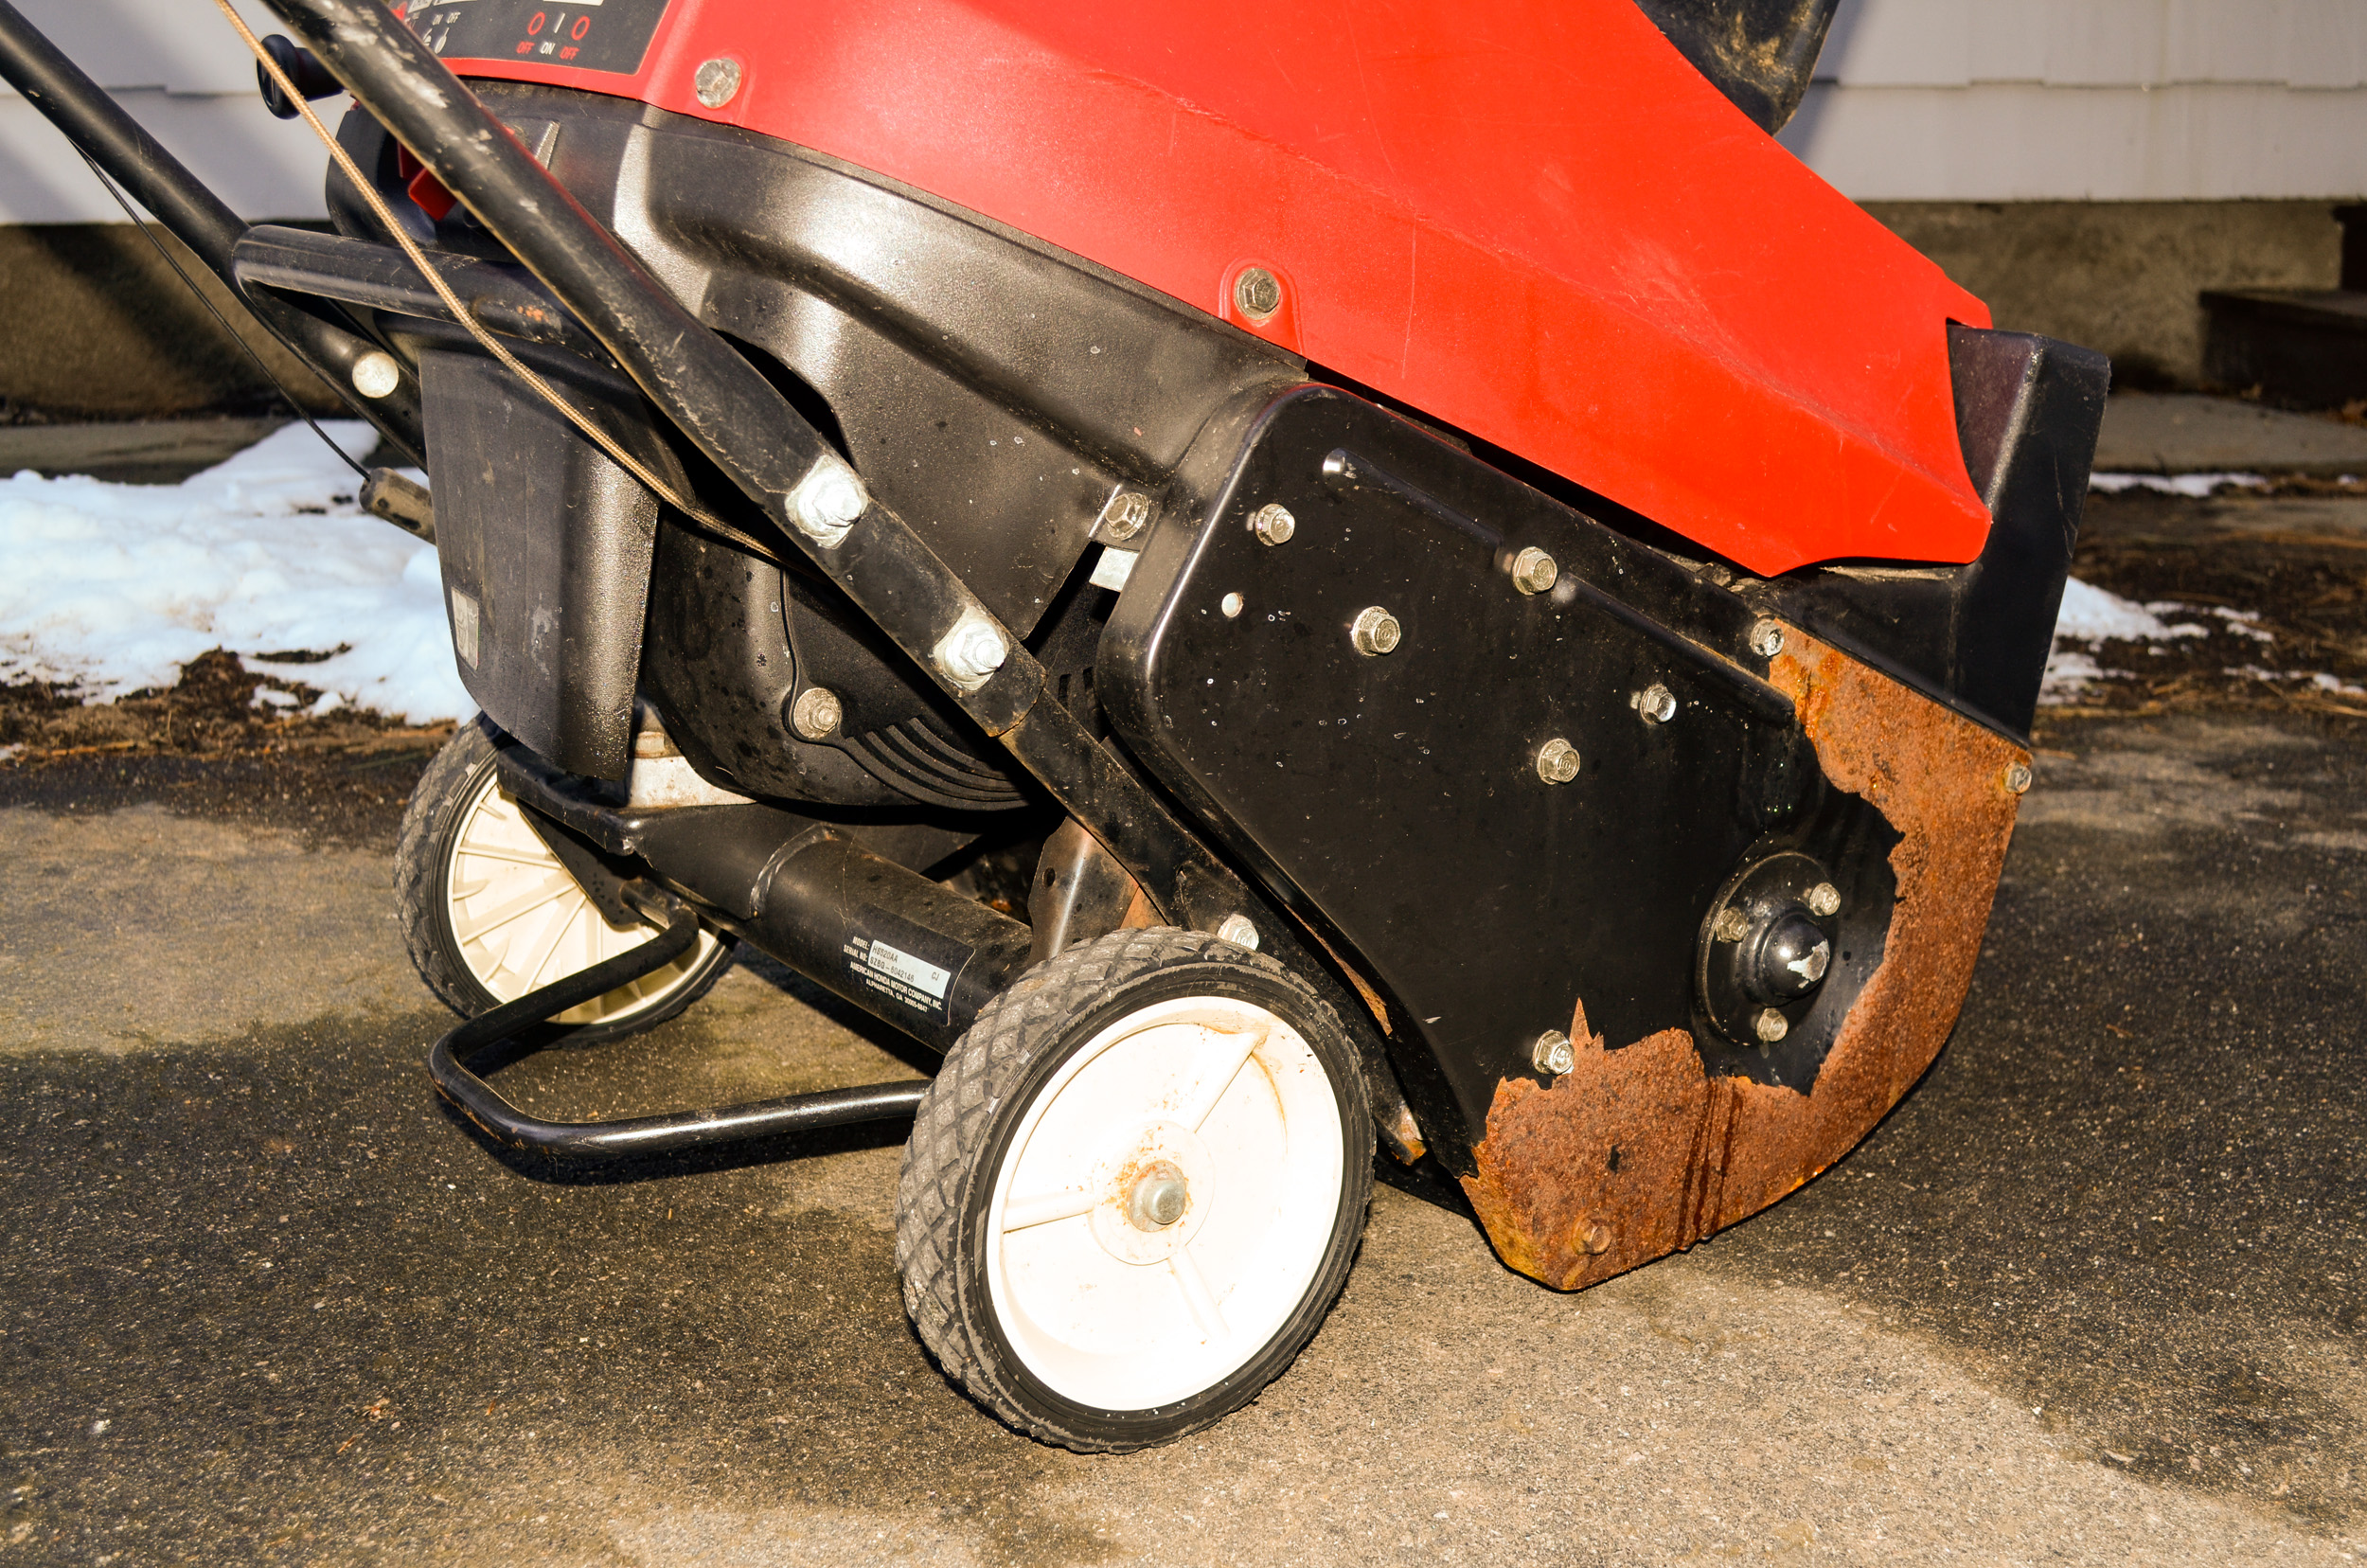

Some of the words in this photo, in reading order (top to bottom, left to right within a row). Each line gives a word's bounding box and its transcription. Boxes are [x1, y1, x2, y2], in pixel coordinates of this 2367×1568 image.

[433, 13, 444, 26] ON
[446, 11, 461, 25] OFF
[516, 41, 535, 54] OFF
[540, 41, 556, 55] ON
[560, 45, 580, 61] OFF
[843, 944, 859, 958] SERIAL
[852, 935, 870, 951] MODEL:
[871, 945, 899, 964] HS520AA
[931, 971, 940, 981] CJ
[849, 961, 874, 979] AMERICAN
[873, 971, 891, 987] HONDA
[890, 979, 908, 995] MOTOR
[895, 992, 903, 1002] GA
